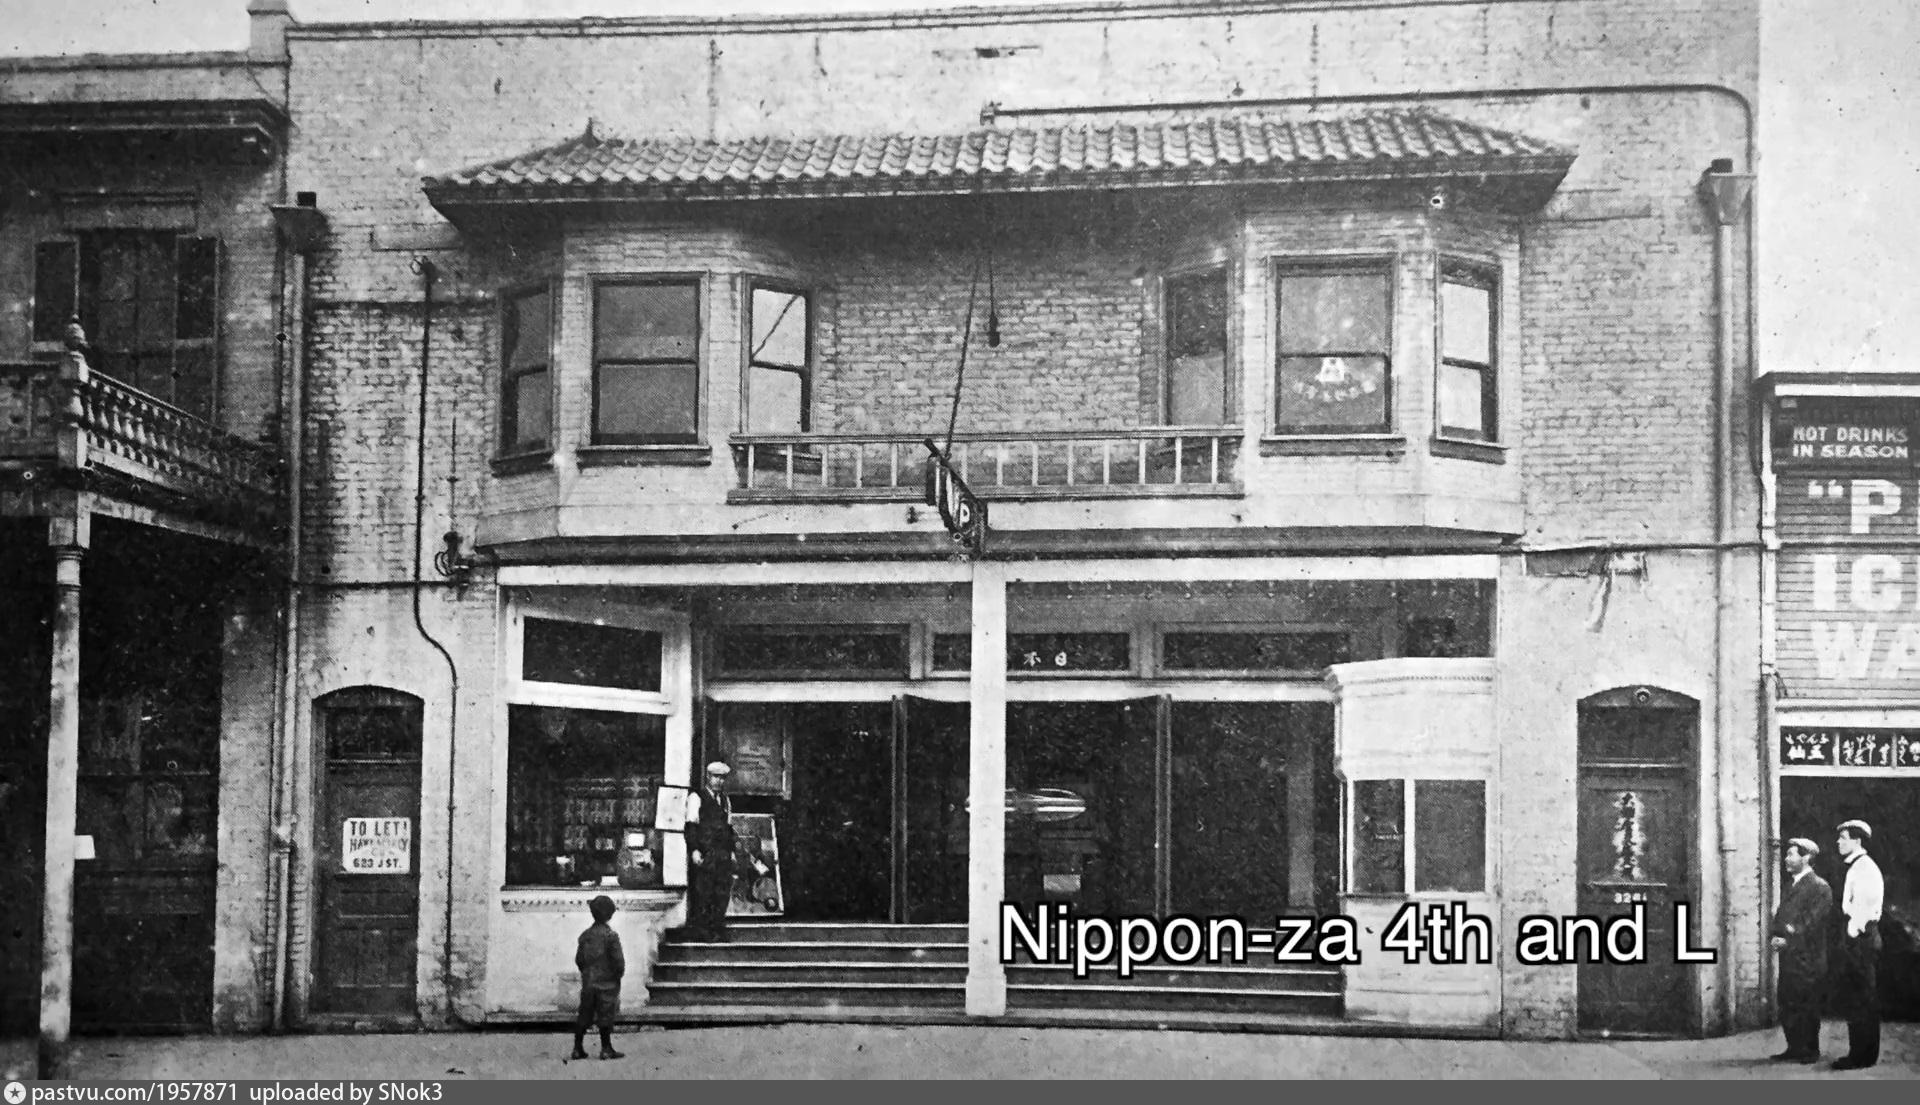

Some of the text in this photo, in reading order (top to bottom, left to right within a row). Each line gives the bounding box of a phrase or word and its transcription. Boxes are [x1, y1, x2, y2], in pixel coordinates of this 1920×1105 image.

[1836, 426, 1908, 443] DRINKS
[1793, 443, 1908, 458] IN SEASON
[1808, 479, 1920, 534] “P
[1814, 554, 1920, 611] IC
[350, 820, 367, 836] TO
[353, 858, 374, 868] 623
